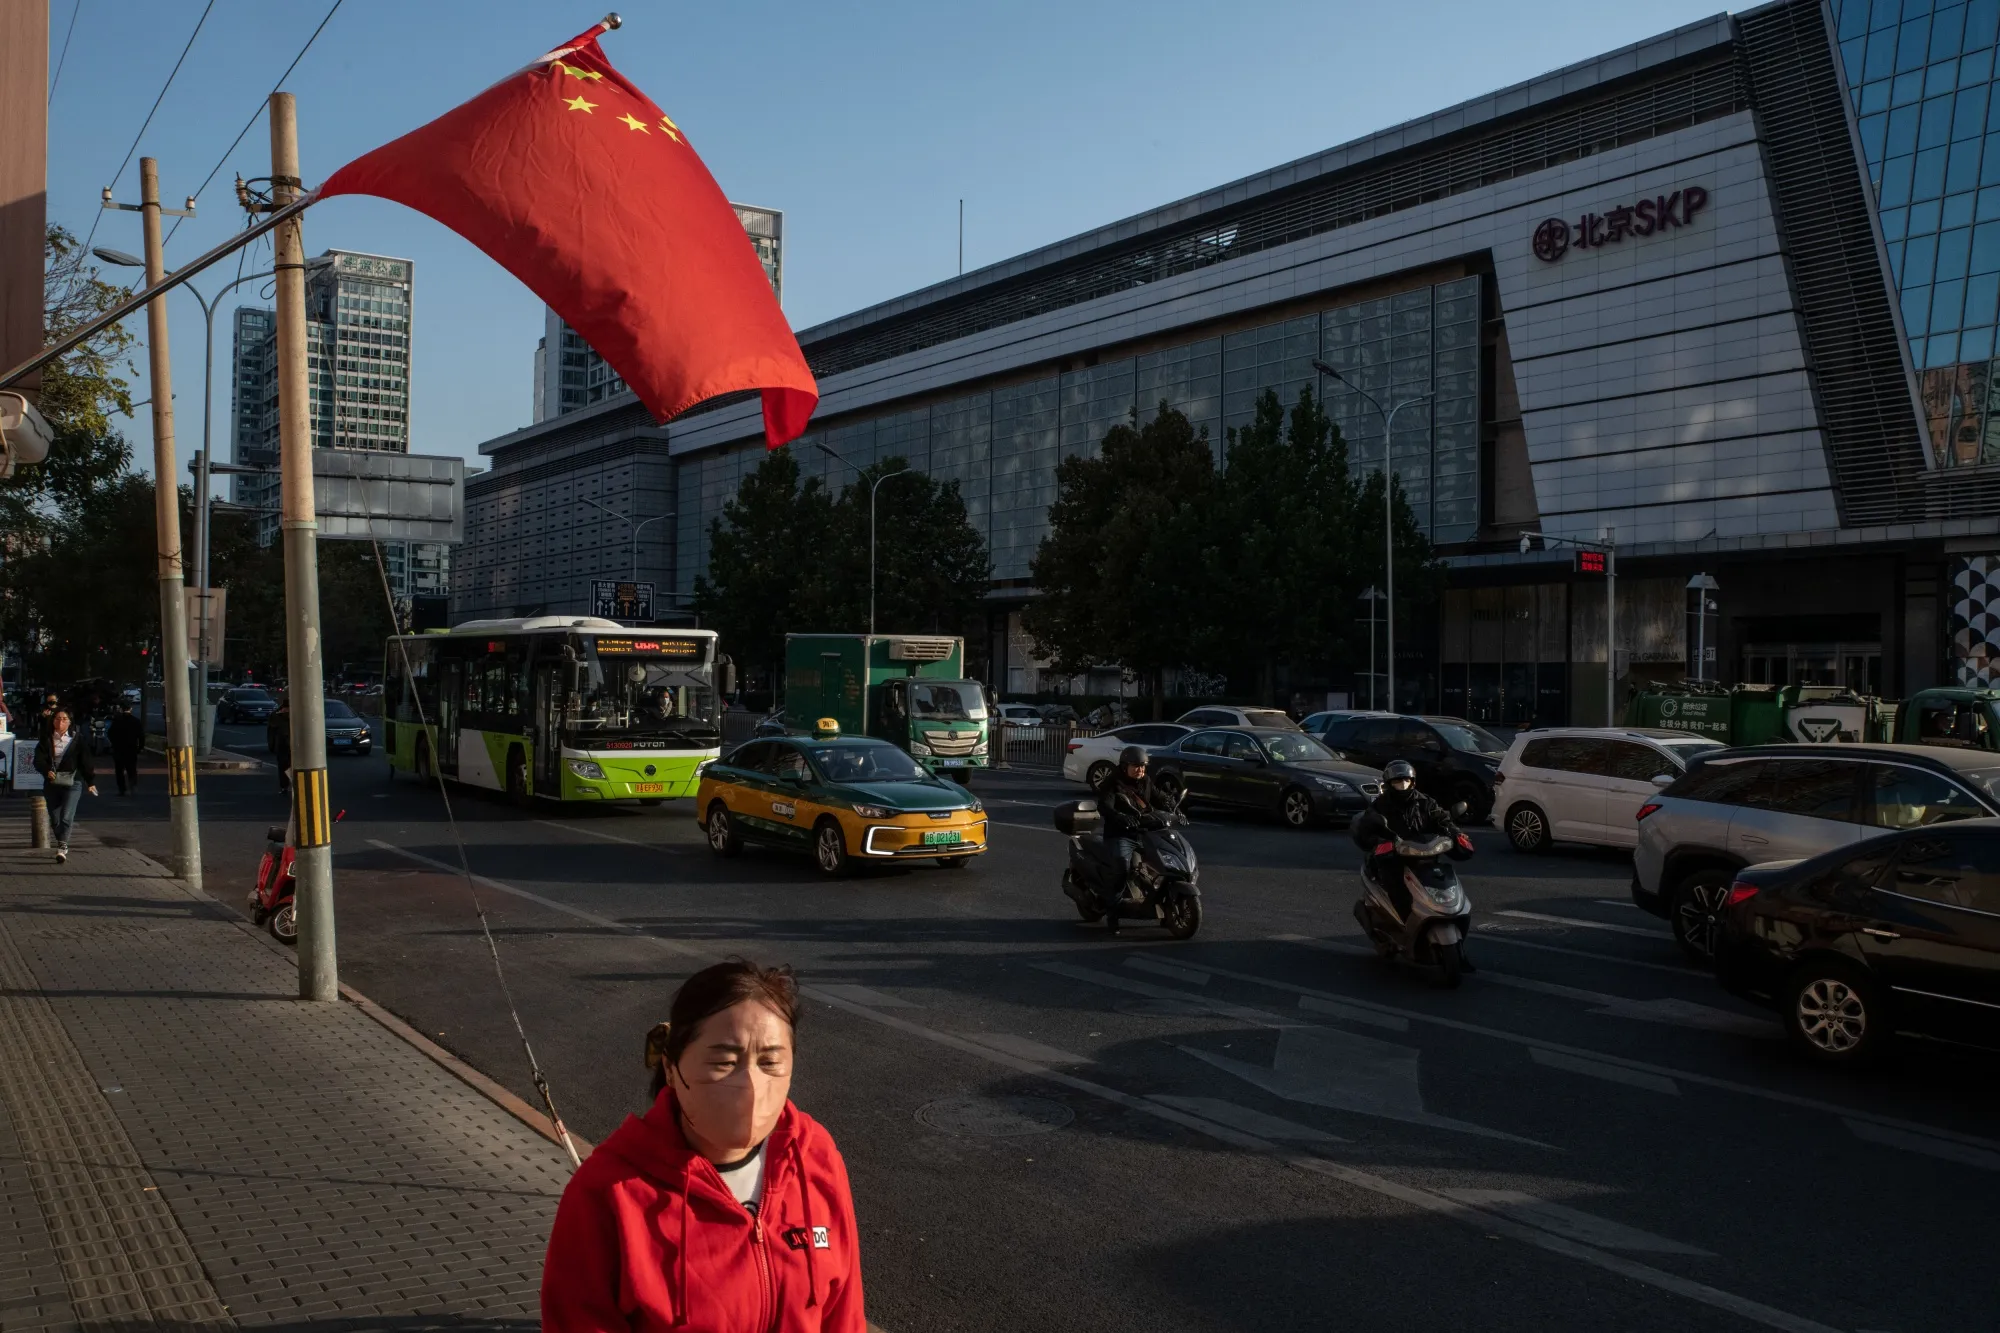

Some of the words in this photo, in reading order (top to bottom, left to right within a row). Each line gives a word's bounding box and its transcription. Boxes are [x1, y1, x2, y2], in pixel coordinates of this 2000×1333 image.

[1572, 186, 1708, 250] 北京SKP
[1659, 719, 1689, 729] 垃圾分类
[1689, 721, 1728, 732] 我们一起来
[814, 1231, 827, 1243] DO
